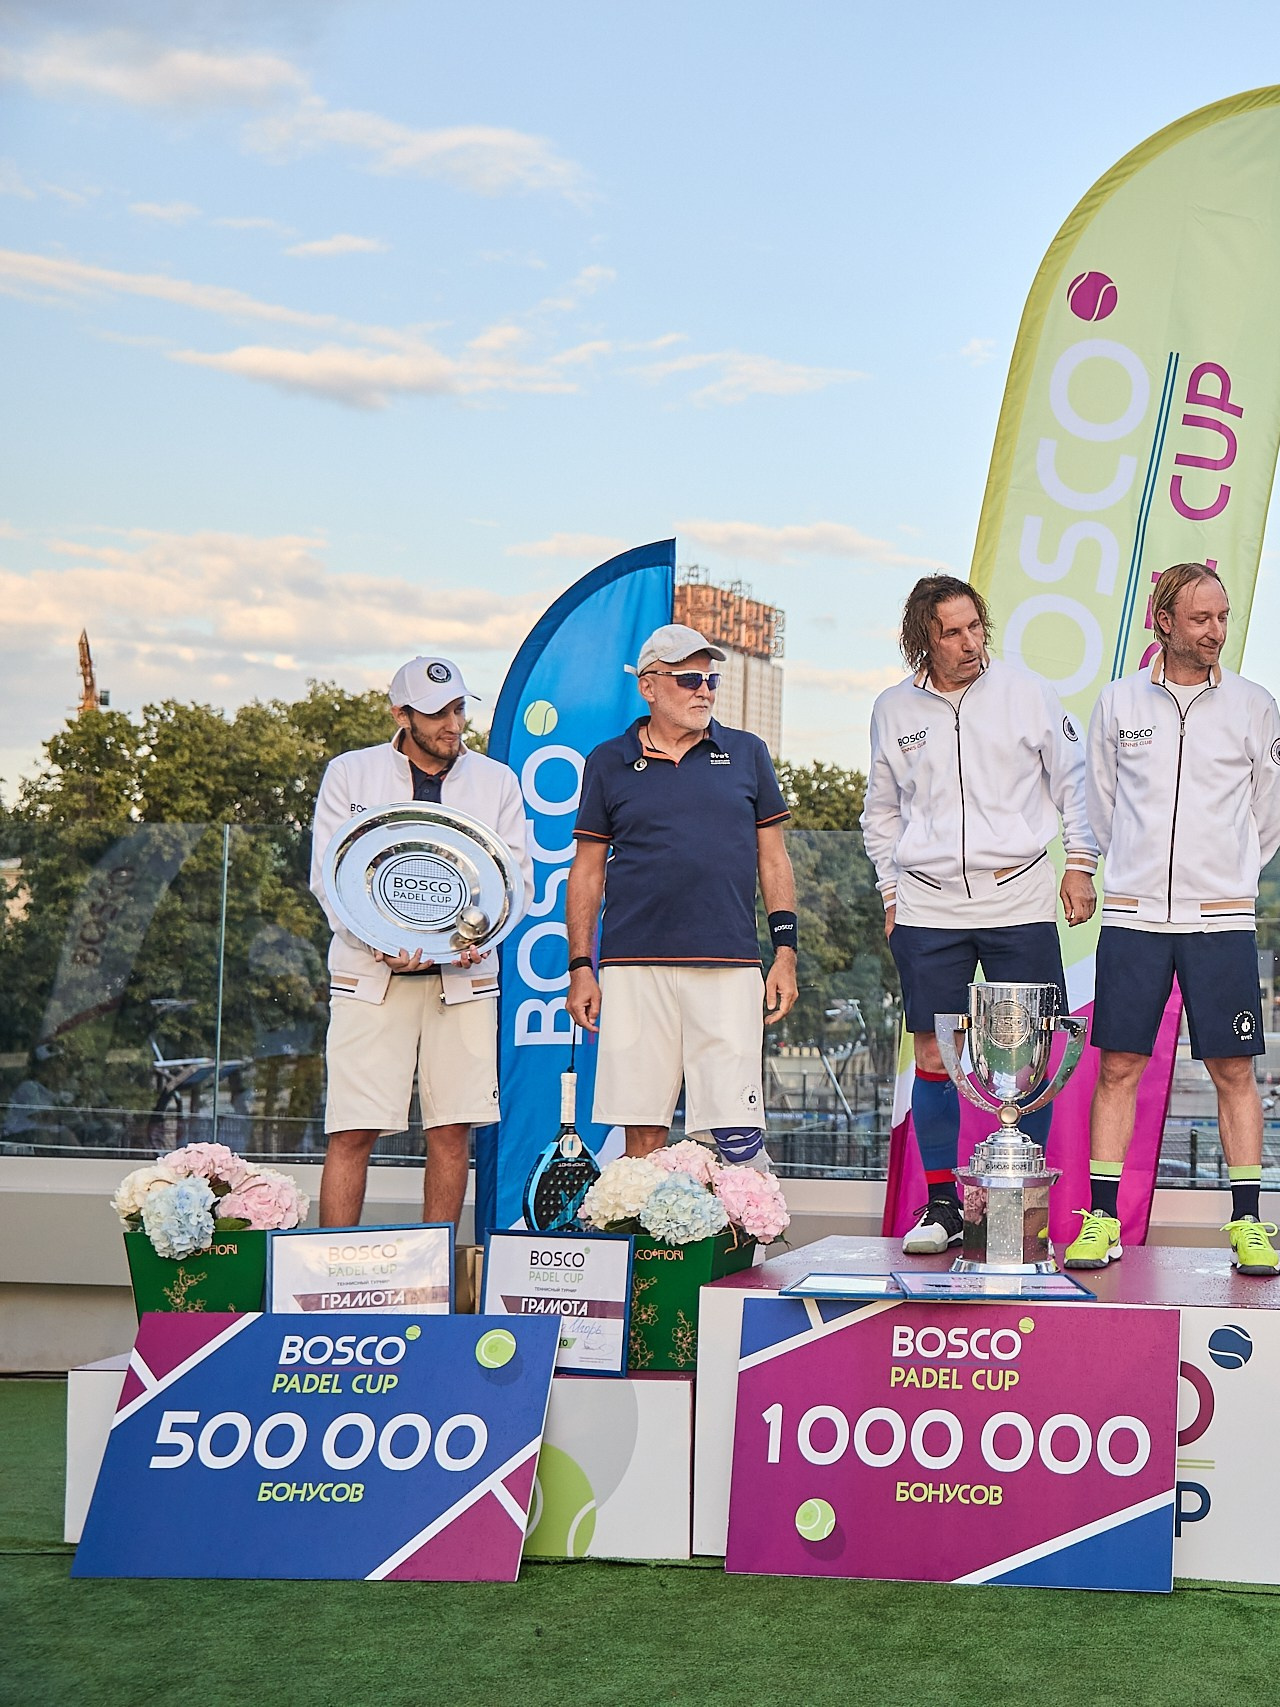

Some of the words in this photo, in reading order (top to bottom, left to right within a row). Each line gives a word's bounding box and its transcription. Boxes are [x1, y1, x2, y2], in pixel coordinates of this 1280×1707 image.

[1169, 361, 1245, 521] CUP
[1003, 338, 1151, 700] OSCO
[897, 730, 927, 747] BOSCO
[1119, 728, 1153, 740] BOSCO
[393, 877, 453, 894] BOSCO
[393, 890, 428, 903] PADEL
[430, 894, 453, 905] CUP
[328, 1243, 398, 1263] BOSCO
[530, 1250, 585, 1268] BOSCO
[657, 1249, 684, 1261] FIORI
[328, 1264, 368, 1278] PADEL
[372, 1263, 398, 1276] CUP
[529, 1271, 560, 1283] PADEL
[564, 1272, 584, 1284] CUP
[320, 1290, 405, 1310] ГРАМОТА
[521, 1297, 588, 1316] ГРАМОТА
[278, 1335, 406, 1366] BOSCO
[891, 1325, 1022, 1361] BOSCO
[272, 1374, 339, 1394] PADEL
[352, 1374, 398, 1394] CUP
[890, 1367, 963, 1391] PADEL
[972, 1370, 1019, 1391] CUP
[149, 1410, 308, 1470] 500
[322, 1412, 488, 1471] 000
[980, 1411, 1151, 1477] 000
[257, 1482, 364, 1503] БОНУСОВ
[895, 1481, 1003, 1506] БОНУСОВ
